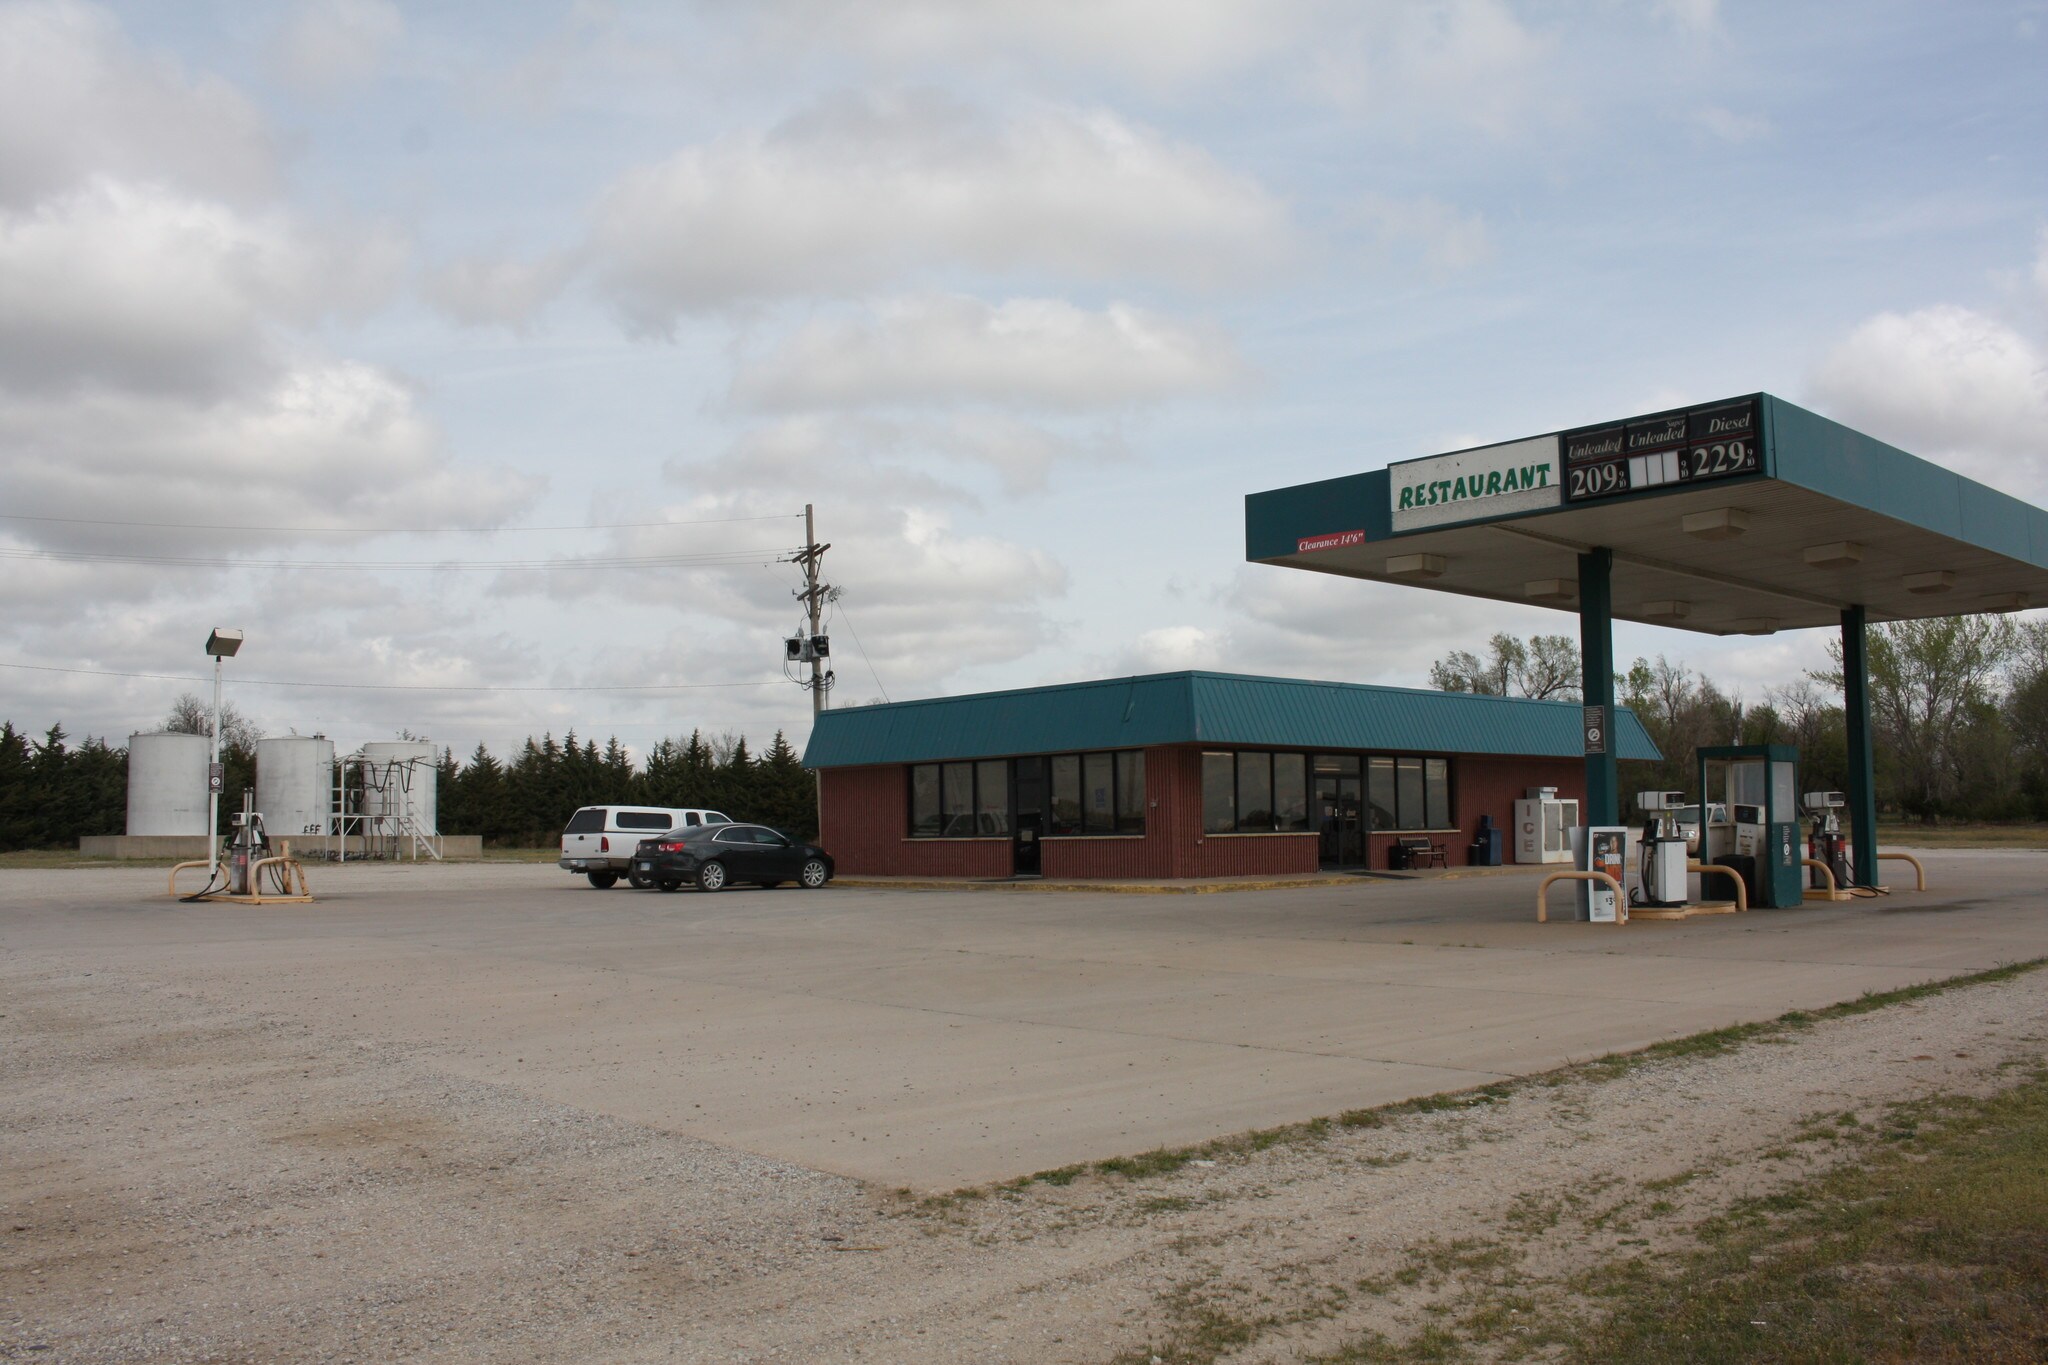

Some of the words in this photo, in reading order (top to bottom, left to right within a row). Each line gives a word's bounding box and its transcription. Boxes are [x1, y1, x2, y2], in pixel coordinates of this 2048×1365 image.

[1666, 419, 1685, 428] Super
[1709, 413, 1751, 433] Diesel
[1569, 438, 1622, 458] Unleaded
[1629, 427, 1685, 448] Unleaded
[1693, 441, 1745, 476] 229
[1398, 463, 1551, 510] RESTAURANT
[1571, 463, 1618, 496] 209
[1298, 538, 1339, 551] Clearance
[1340, 532, 1363, 545] 14'6"
[1523, 805, 1535, 852] ICE
